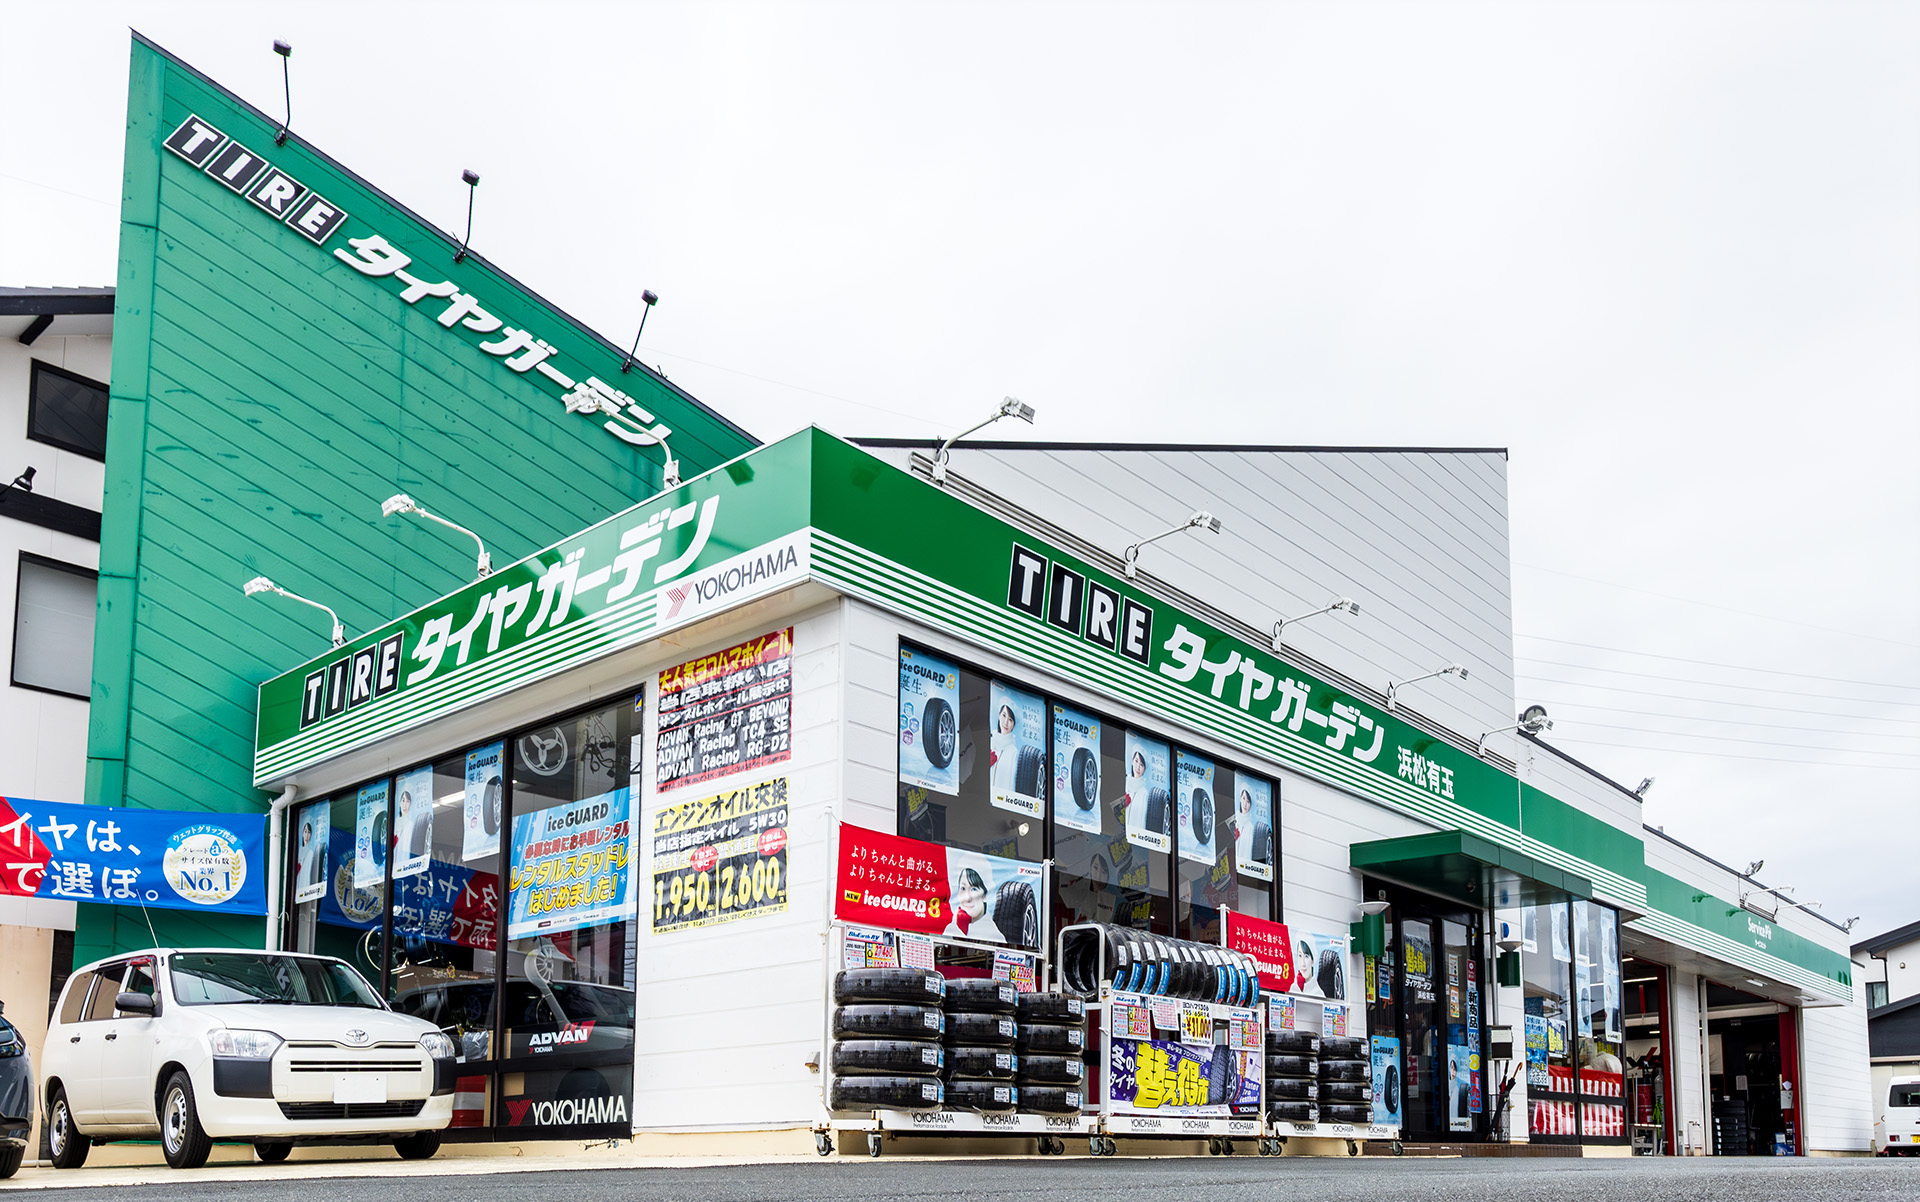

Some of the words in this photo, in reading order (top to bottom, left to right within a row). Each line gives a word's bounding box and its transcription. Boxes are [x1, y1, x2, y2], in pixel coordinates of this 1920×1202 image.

[181, 121, 334, 234] TIRE
[333, 233, 672, 447] タイヤガーデン
[694, 545, 798, 605] YOKOHAMA
[307, 638, 399, 722] TIRE
[405, 494, 721, 687] タイヤガーデン
[659, 629, 792, 695] 大人気ヨコハマホイール
[900, 658, 946, 684] iceGUARD
[945, 673, 956, 690] 8
[1017, 550, 1146, 656] TIRE
[1158, 623, 1385, 763] タイヤガーデン
[1396, 744, 1456, 800] 浜松有玉
[658, 678, 790, 729] サンプルホイール展示中
[657, 726, 691, 750] ADVAN
[692, 718, 726, 741] Racing
[729, 711, 744, 729] GT
[748, 697, 790, 723] BEYOND
[1089, 725, 1097, 740] 8
[656, 742, 693, 767] ADVAN
[698, 733, 736, 755] Racing
[741, 721, 766, 742] TC4
[773, 714, 789, 734] SE
[656, 758, 694, 783] ADVAN
[701, 749, 740, 771] Racing
[745, 732, 788, 759] RG-D2
[1177, 761, 1205, 777] ceGUARD
[1204, 767, 1212, 781] 8
[547, 802, 609, 833] iceGUARD
[654, 777, 788, 834] エンジンオイル交換
[1005, 795, 1034, 811] iceGUARD
[1033, 803, 1040, 813] 8
[0, 811, 141, 857] イヤは、
[654, 822, 740, 854] 当店指定オイル
[748, 809, 787, 832] 5W30
[1137, 833, 1161, 847] iceGUARD
[850, 844, 938, 875] よりちゃんと曲がる、
[6, 860, 159, 902] で選ぼ。
[178, 870, 233, 892] No.1
[721, 856, 781, 910] 2,600
[849, 864, 937, 893] よりちゃんと止まる。
[656, 871, 710, 921] 1,950
[846, 892, 861, 902] NEW
[862, 889, 927, 914] iceGUARD
[927, 897, 941, 918] 8
[1235, 926, 1286, 947] よりちゃんと曲がる、
[1235, 940, 1287, 960] よりちゃんと止まる。
[1282, 962, 1290, 980] 8
[1405, 978, 1433, 991] タイヤガーデン
[528, 1028, 588, 1046] ADVAN
[1111, 1044, 1135, 1074] 冬の
[1469, 1054, 1480, 1070] 8
[1109, 1073, 1135, 1090] タイヤ
[532, 1095, 628, 1126] YOKOHAMA
[911, 1112, 955, 1128] YOKOHAMA
[981, 1114, 1020, 1129] YOKOHAMA
[1045, 1117, 1080, 1130] YOKOHAMA
[1131, 1119, 1162, 1129] YOKOHAMA
[1182, 1121, 1210, 1130] YOKOHAMA
[1228, 1122, 1255, 1131] YOKOHAMA
